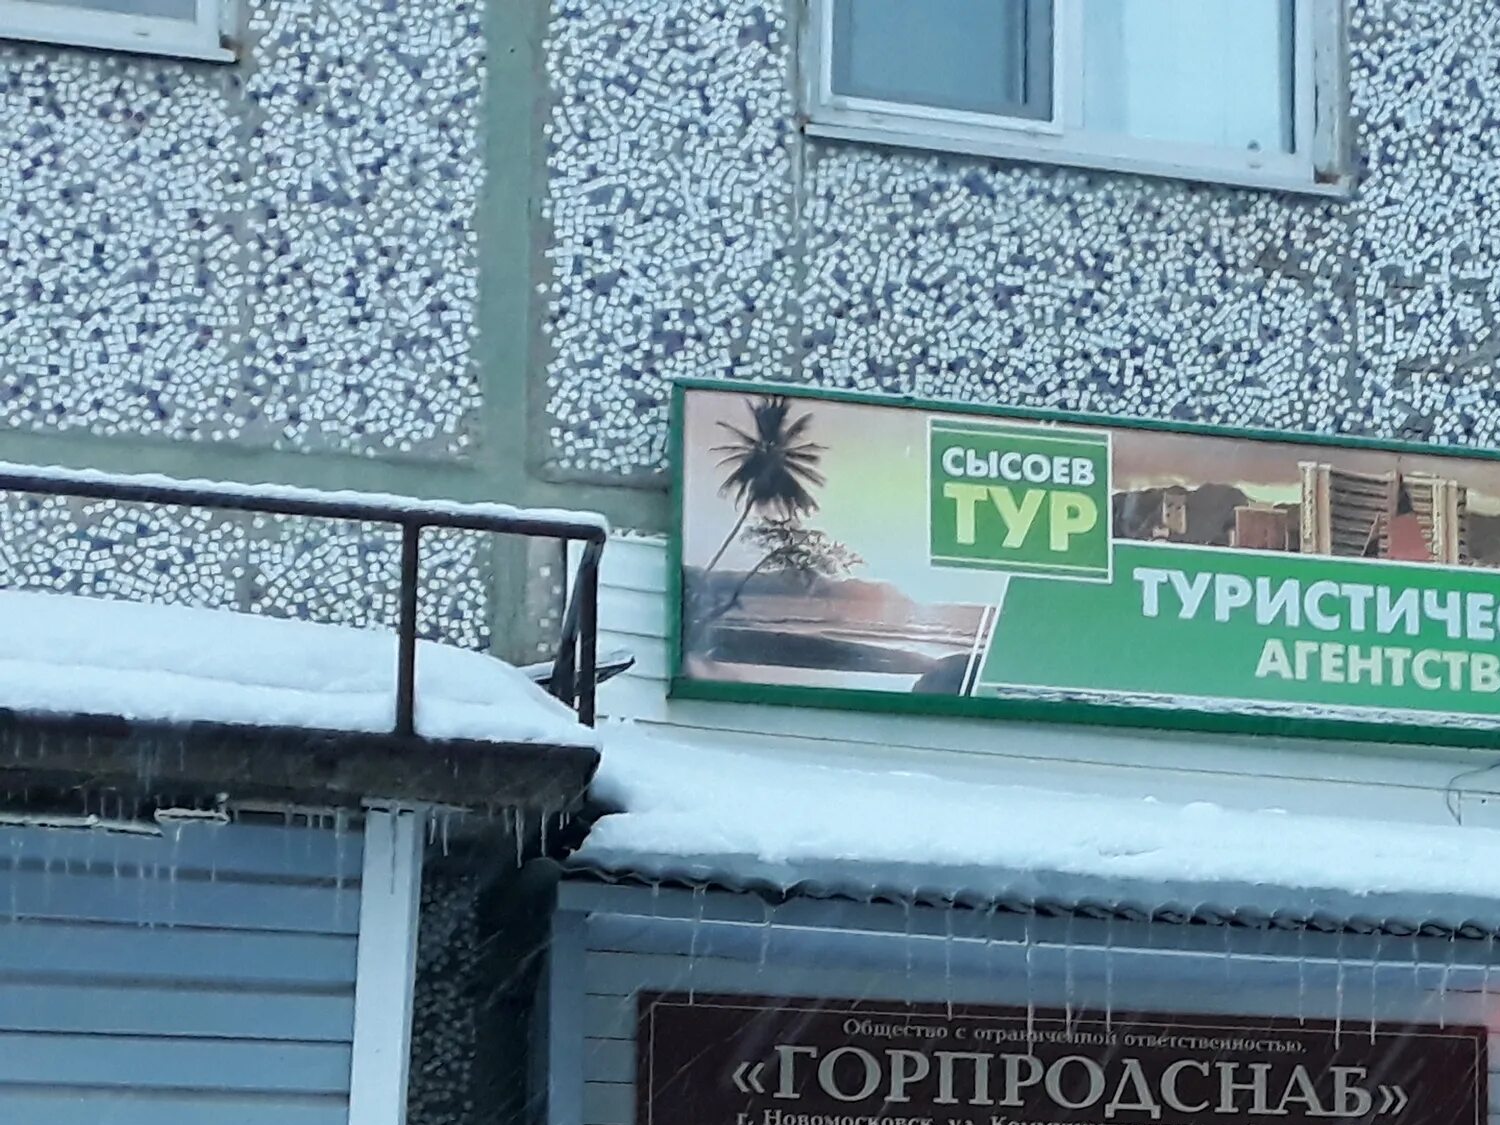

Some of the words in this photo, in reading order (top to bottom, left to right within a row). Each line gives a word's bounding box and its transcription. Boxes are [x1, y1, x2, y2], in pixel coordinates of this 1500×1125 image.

[941, 446, 1096, 486] СЫСОЕВ
[943, 480, 1099, 552] ТУР
[843, 1018, 948, 1040] Общество
[955, 1027, 967, 1039] с
[973, 1028, 1118, 1046] ограниченной
[731, 1043, 1409, 1120] «ГОРПРОДСНАБ»
